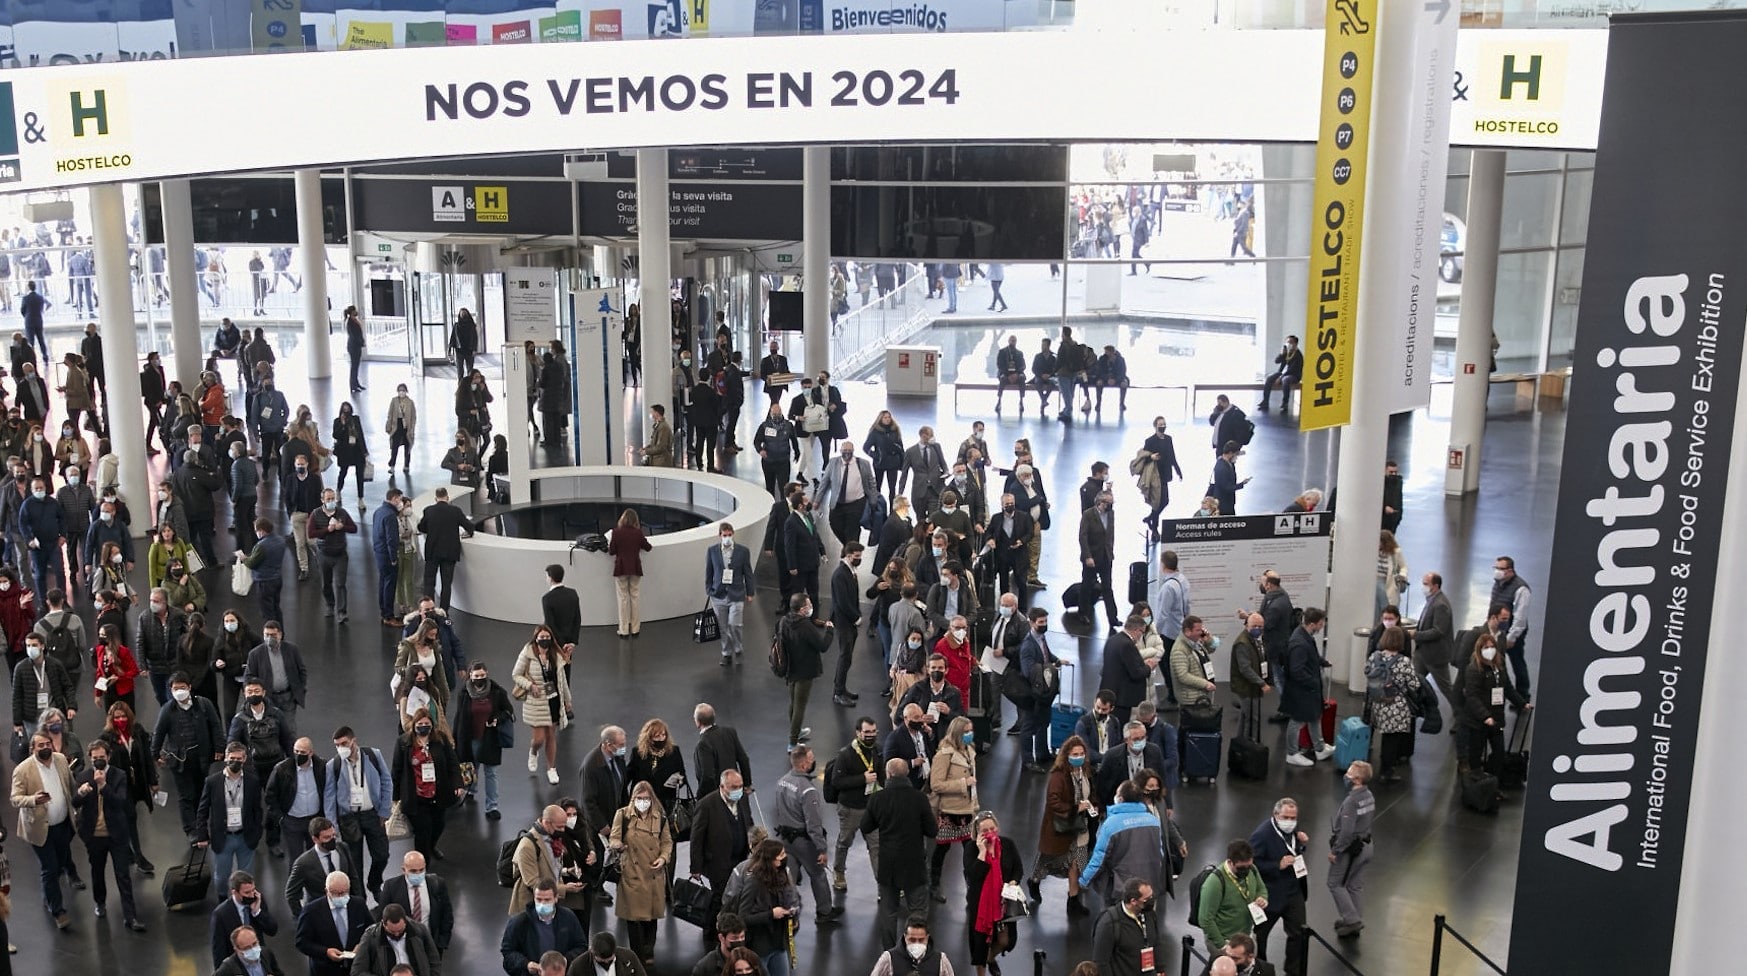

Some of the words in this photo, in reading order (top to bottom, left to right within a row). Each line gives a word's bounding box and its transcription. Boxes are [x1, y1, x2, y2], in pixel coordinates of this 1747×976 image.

[500, 29, 526, 40] HOSTELCO
[1342, 59, 1356, 72] P4
[1453, 71, 1468, 101] &
[1500, 55, 1542, 100] H
[425, 80, 531, 120] NOS
[547, 74, 729, 115] VEMOS
[747, 72, 812, 108] EN
[830, 69, 960, 107] 2024
[1340, 95, 1352, 107] P6
[24, 112, 46, 144] &
[70, 90, 108, 137] H
[1475, 120, 1558, 134] HOSTELCO
[1338, 130, 1350, 142] P7
[57, 155, 131, 172] HOSTELCO
[1334, 166, 1351, 178] CC7
[441, 190, 456, 208] A
[466, 197, 475, 209] &
[484, 192, 498, 208] H
[617, 190, 638, 199] Gràc
[672, 191, 681, 200] la
[708, 192, 733, 201] visita
[617, 203, 638, 212] Grac
[683, 204, 706, 213] visita
[618, 215, 637, 224] Than
[684, 217, 700, 225] visit
[1405, 284, 1419, 386] acreditacions
[1424, 50, 1438, 144] registrations
[1314, 200, 1345, 408] HOSTELCO
[1341, 272, 1351, 336] RESTAURANT
[1692, 272, 1724, 392] Exhibition
[1681, 400, 1710, 488] Service
[1280, 518, 1288, 527] A
[1306, 517, 1314, 526] H
[1673, 494, 1698, 555] Food
[1544, 273, 1689, 872] Alimentaria
[1671, 562, 1691, 578] &
[1662, 585, 1687, 657] Drinks
[1653, 665, 1681, 729] Food,
[1637, 736, 1670, 869] International
